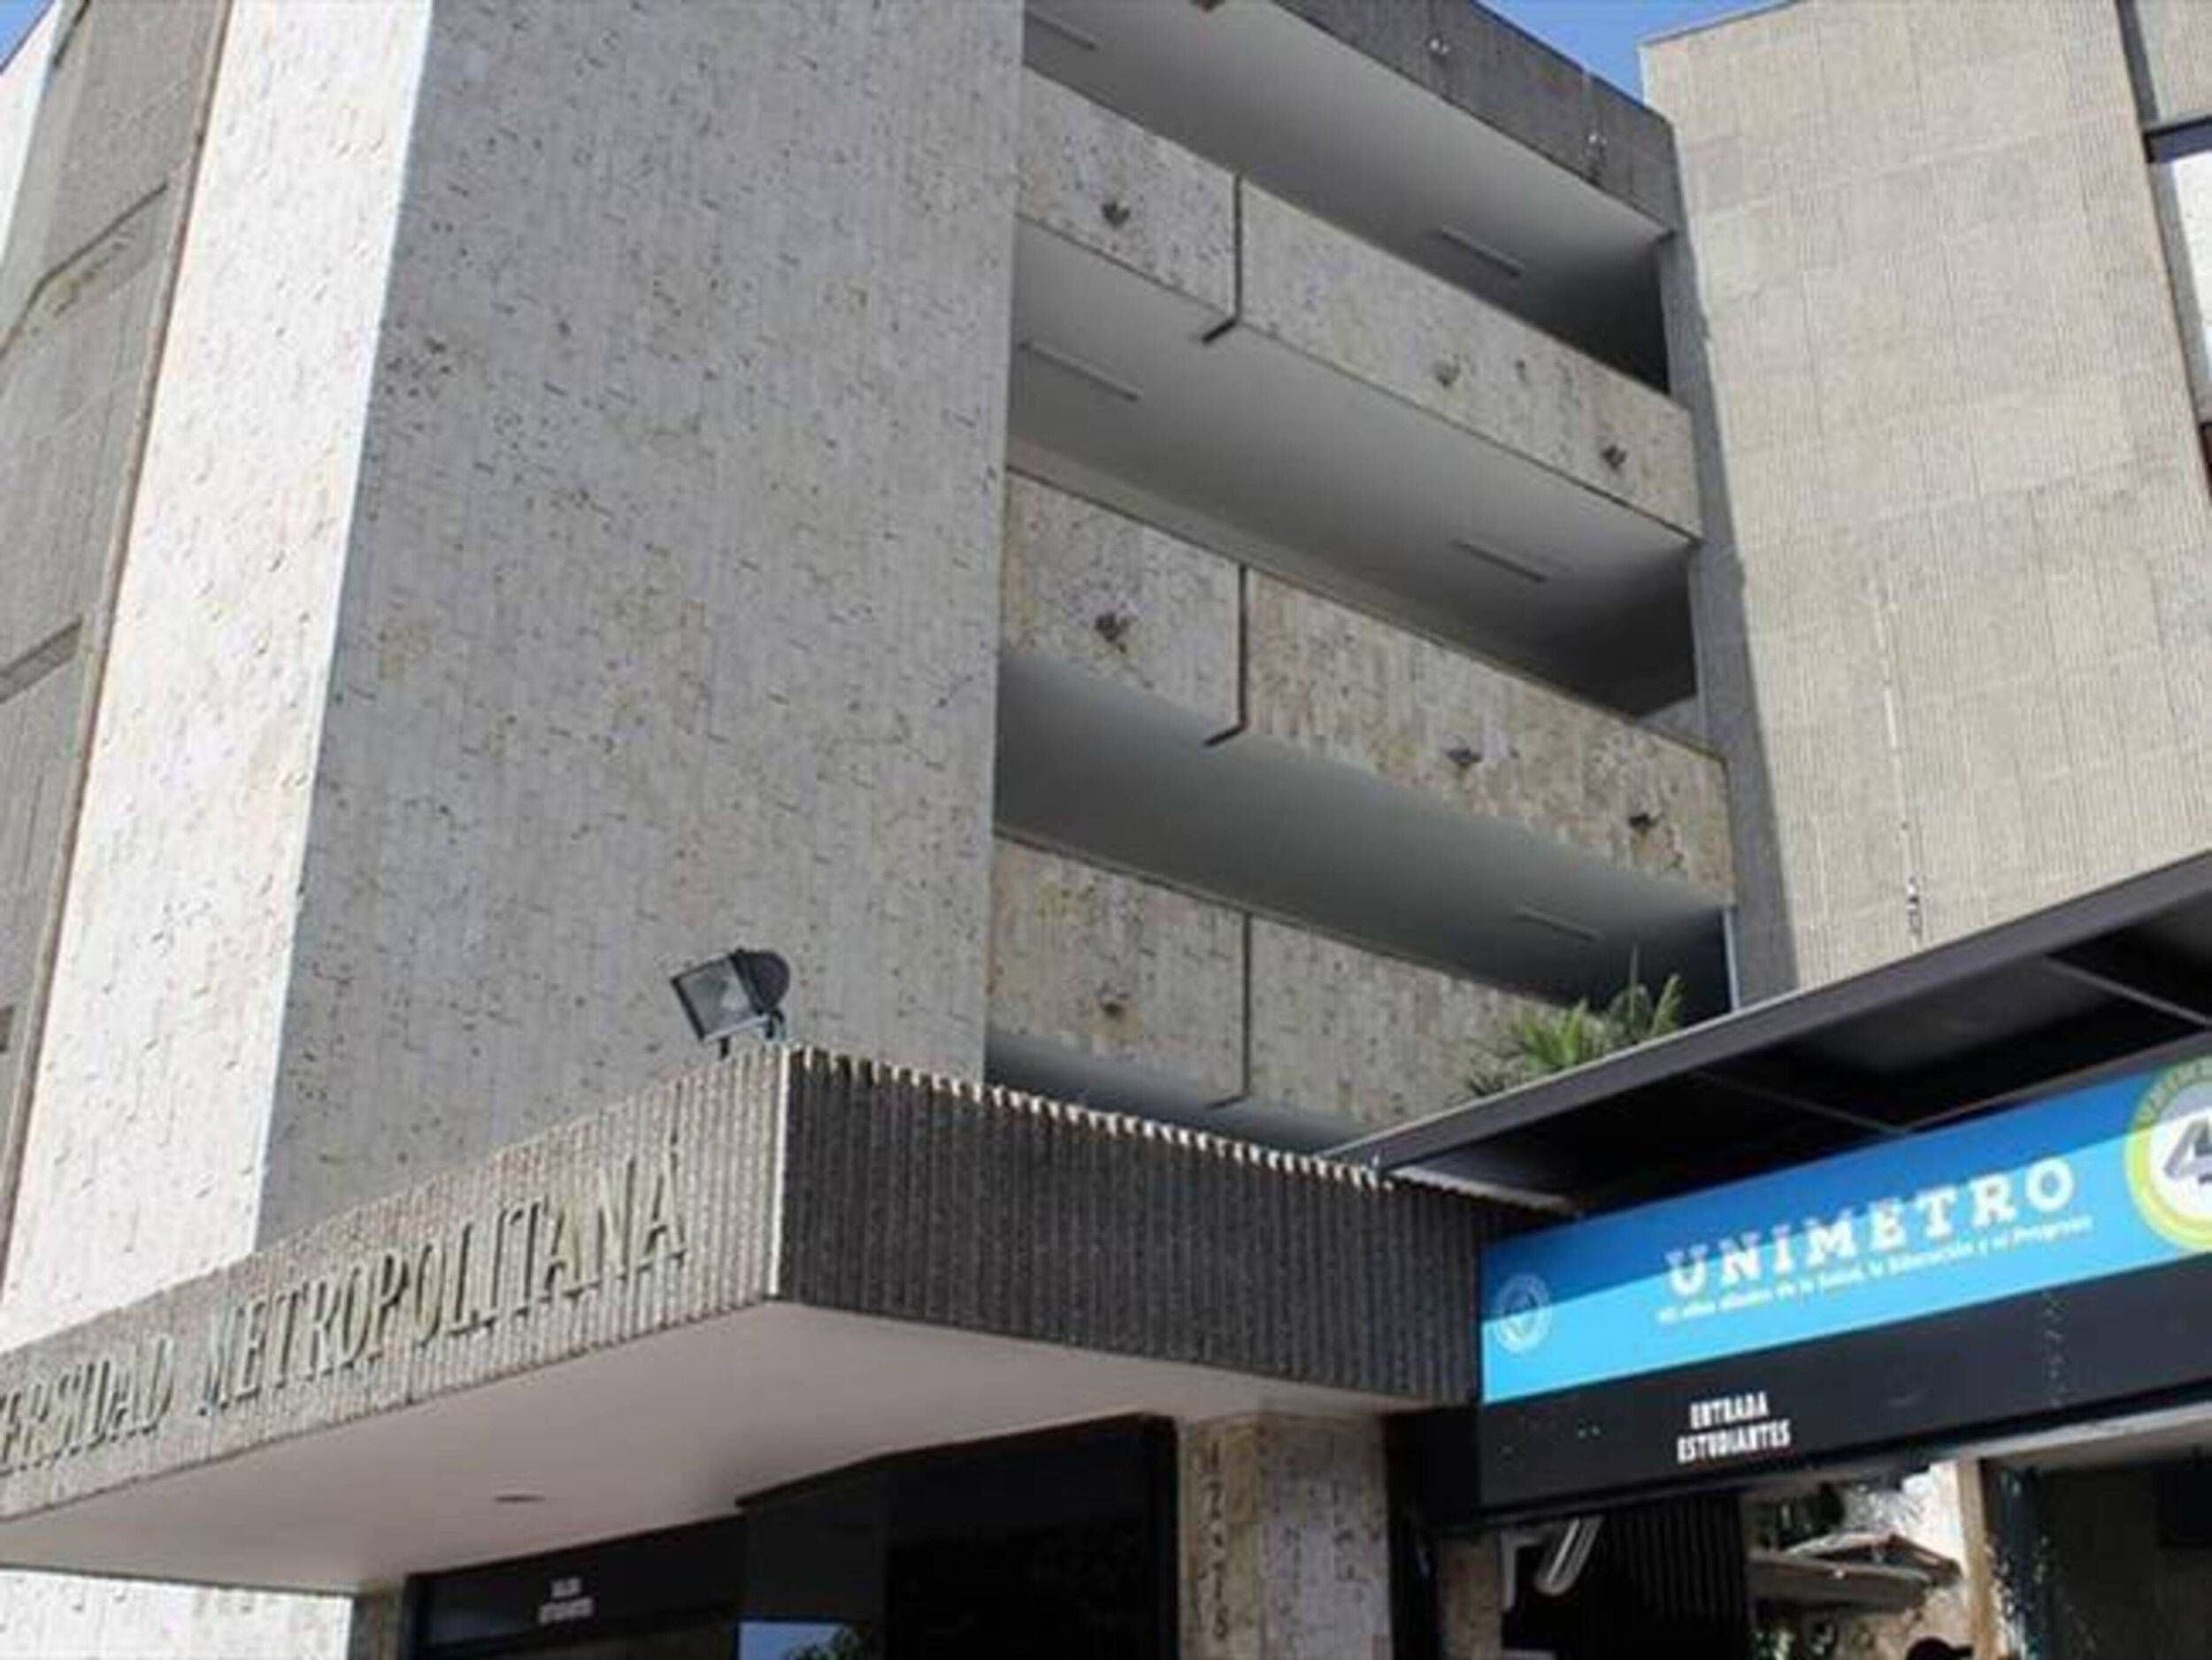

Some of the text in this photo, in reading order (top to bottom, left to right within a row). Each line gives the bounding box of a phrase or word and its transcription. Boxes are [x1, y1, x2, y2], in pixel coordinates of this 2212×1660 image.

[1664, 1157, 2074, 1297] UNIMETRO
[196, 1147, 687, 1418] METROPOLITANA
[1678, 1418, 1791, 1464] ESTUDIANTES
[1690, 1391, 1769, 1430] ENTRADA
